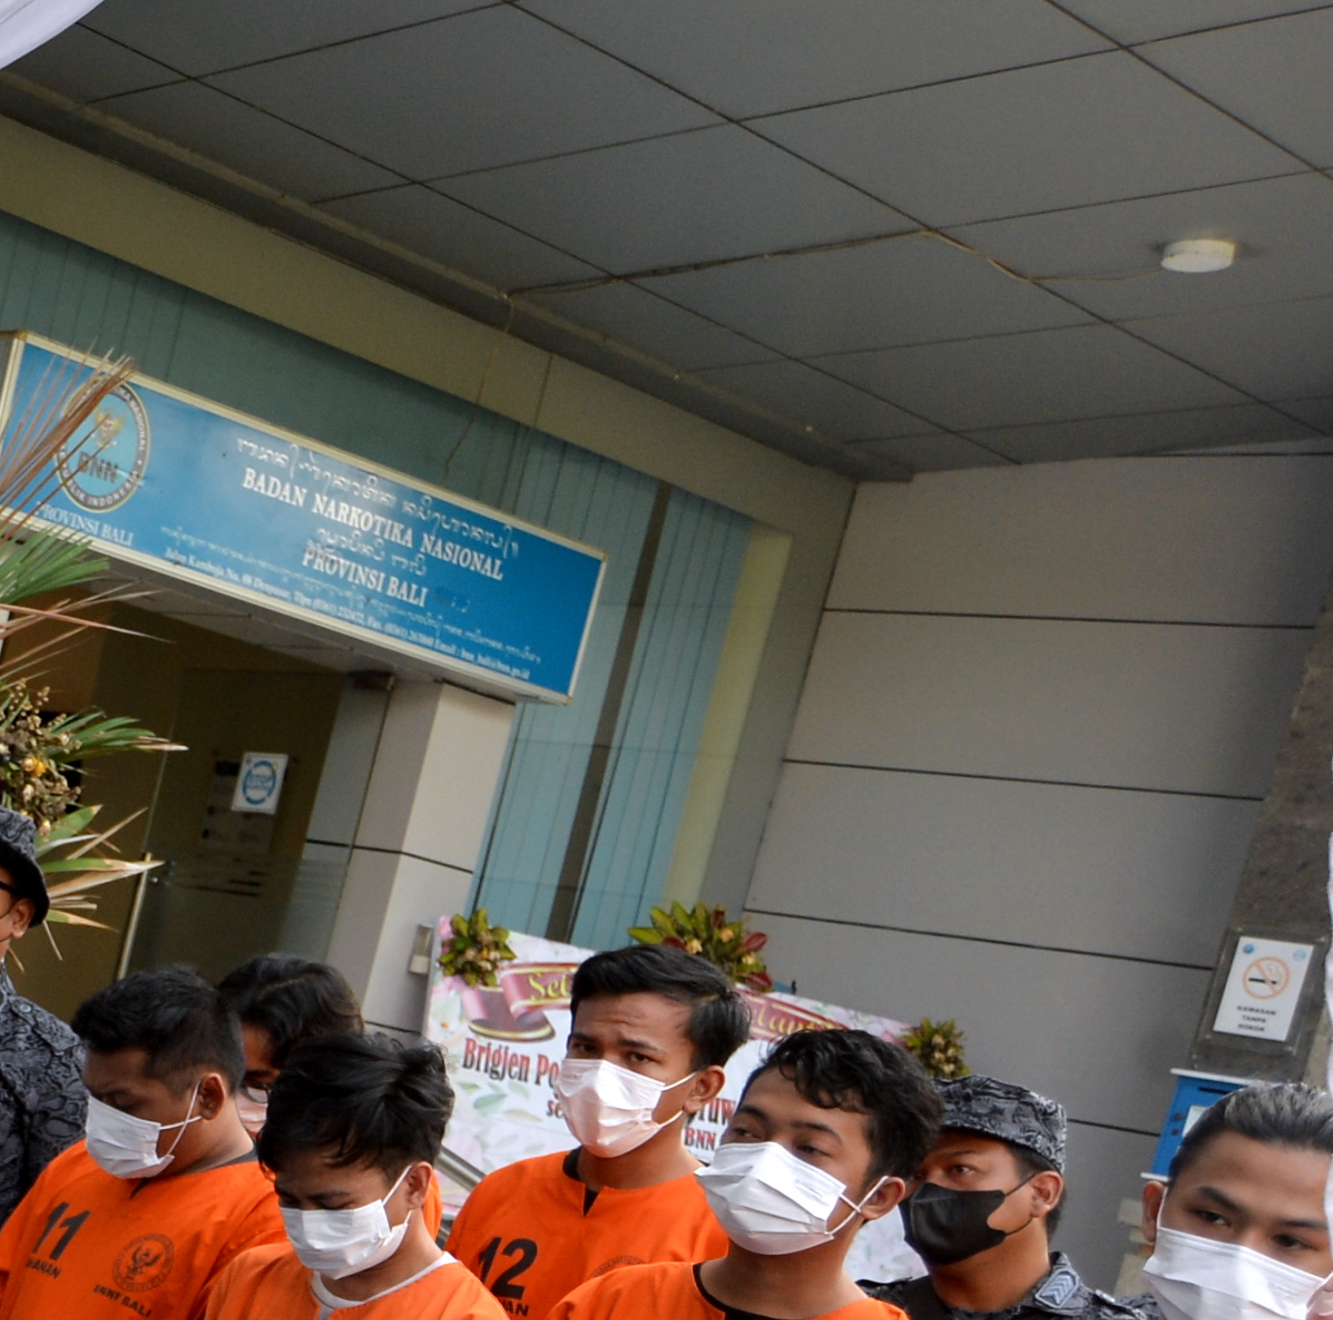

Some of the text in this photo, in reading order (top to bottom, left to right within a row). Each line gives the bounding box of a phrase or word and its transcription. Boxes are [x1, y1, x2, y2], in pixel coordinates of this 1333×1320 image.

[100, 523, 134, 547] BALI
[242, 467, 308, 508] BADAN
[311, 493, 414, 548] NARKOTIKA
[419, 532, 505, 581] NASIONAL
[301, 545, 384, 593] PROVINSI
[386, 573, 429, 608] BALI
[462, 1037, 531, 1082] Brigjen
[33, 1202, 92, 1261] 11
[478, 1236, 539, 1300] 12
[121, 1296, 153, 1318] BALI
